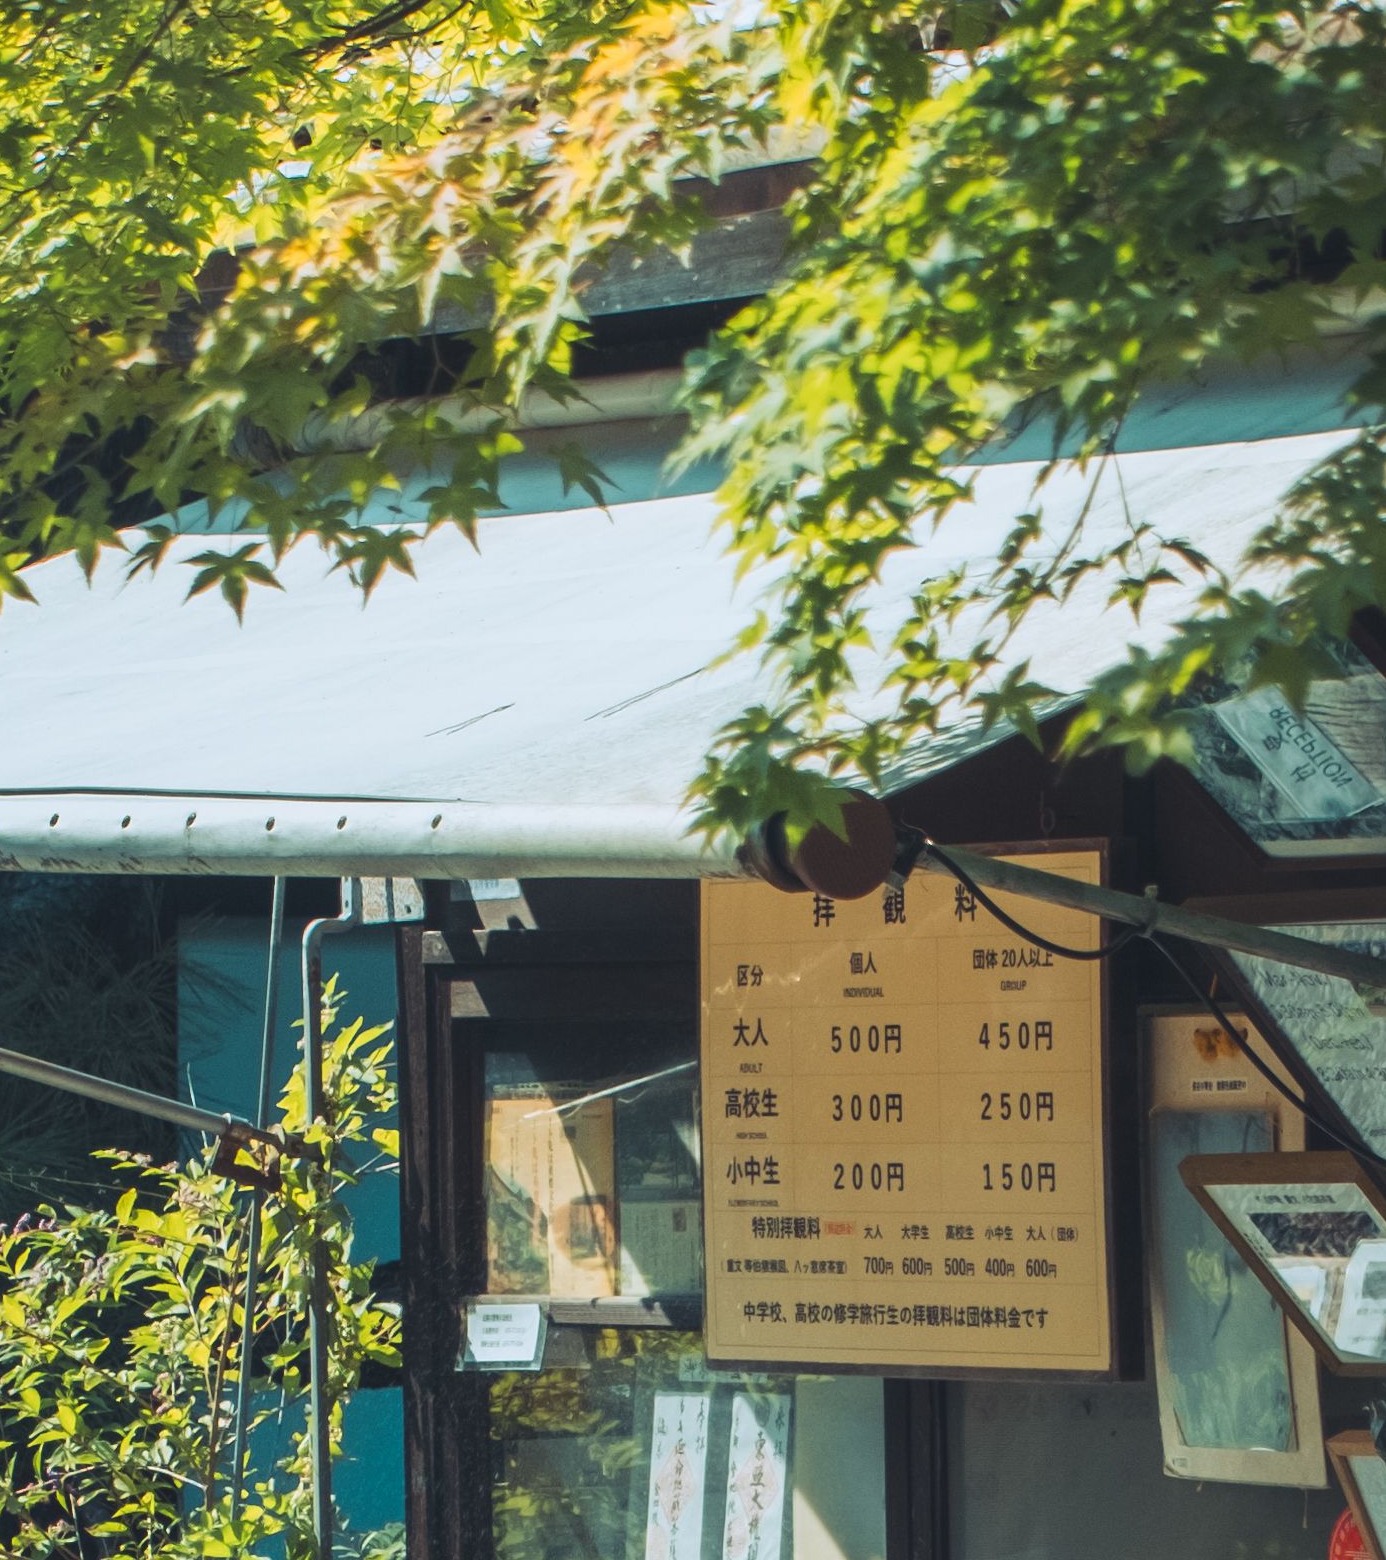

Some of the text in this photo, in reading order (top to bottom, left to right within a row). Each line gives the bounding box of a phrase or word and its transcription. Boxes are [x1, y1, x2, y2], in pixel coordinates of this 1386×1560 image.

[813, 885, 978, 928] 拝観料
[737, 945, 1056, 988] 区分 個人 団体 20人以上
[844, 980, 1029, 1000] INDIVIDUAL GROUP
[733, 1018, 1054, 1055] 大人 500円 450円
[740, 1063, 764, 1075] ADULT
[725, 1088, 1055, 1124] 高校生 300円 250円
[727, 1156, 1057, 1194] 小中生 200円 150円
[752, 1217, 822, 1241] 特別拝観料
[864, 1225, 884, 1241] 大人
[901, 1225, 931, 1241] 大学生
[946, 1225, 976, 1242] 高校生
[985, 1226, 1015, 1242] 小中生
[864, 1257, 895, 1276] 700円
[902, 1257, 934, 1277] 600円
[945, 1258, 976, 1278] 500円
[985, 1258, 1016, 1278] 400円
[1026, 1259, 1058, 1280] 600円
